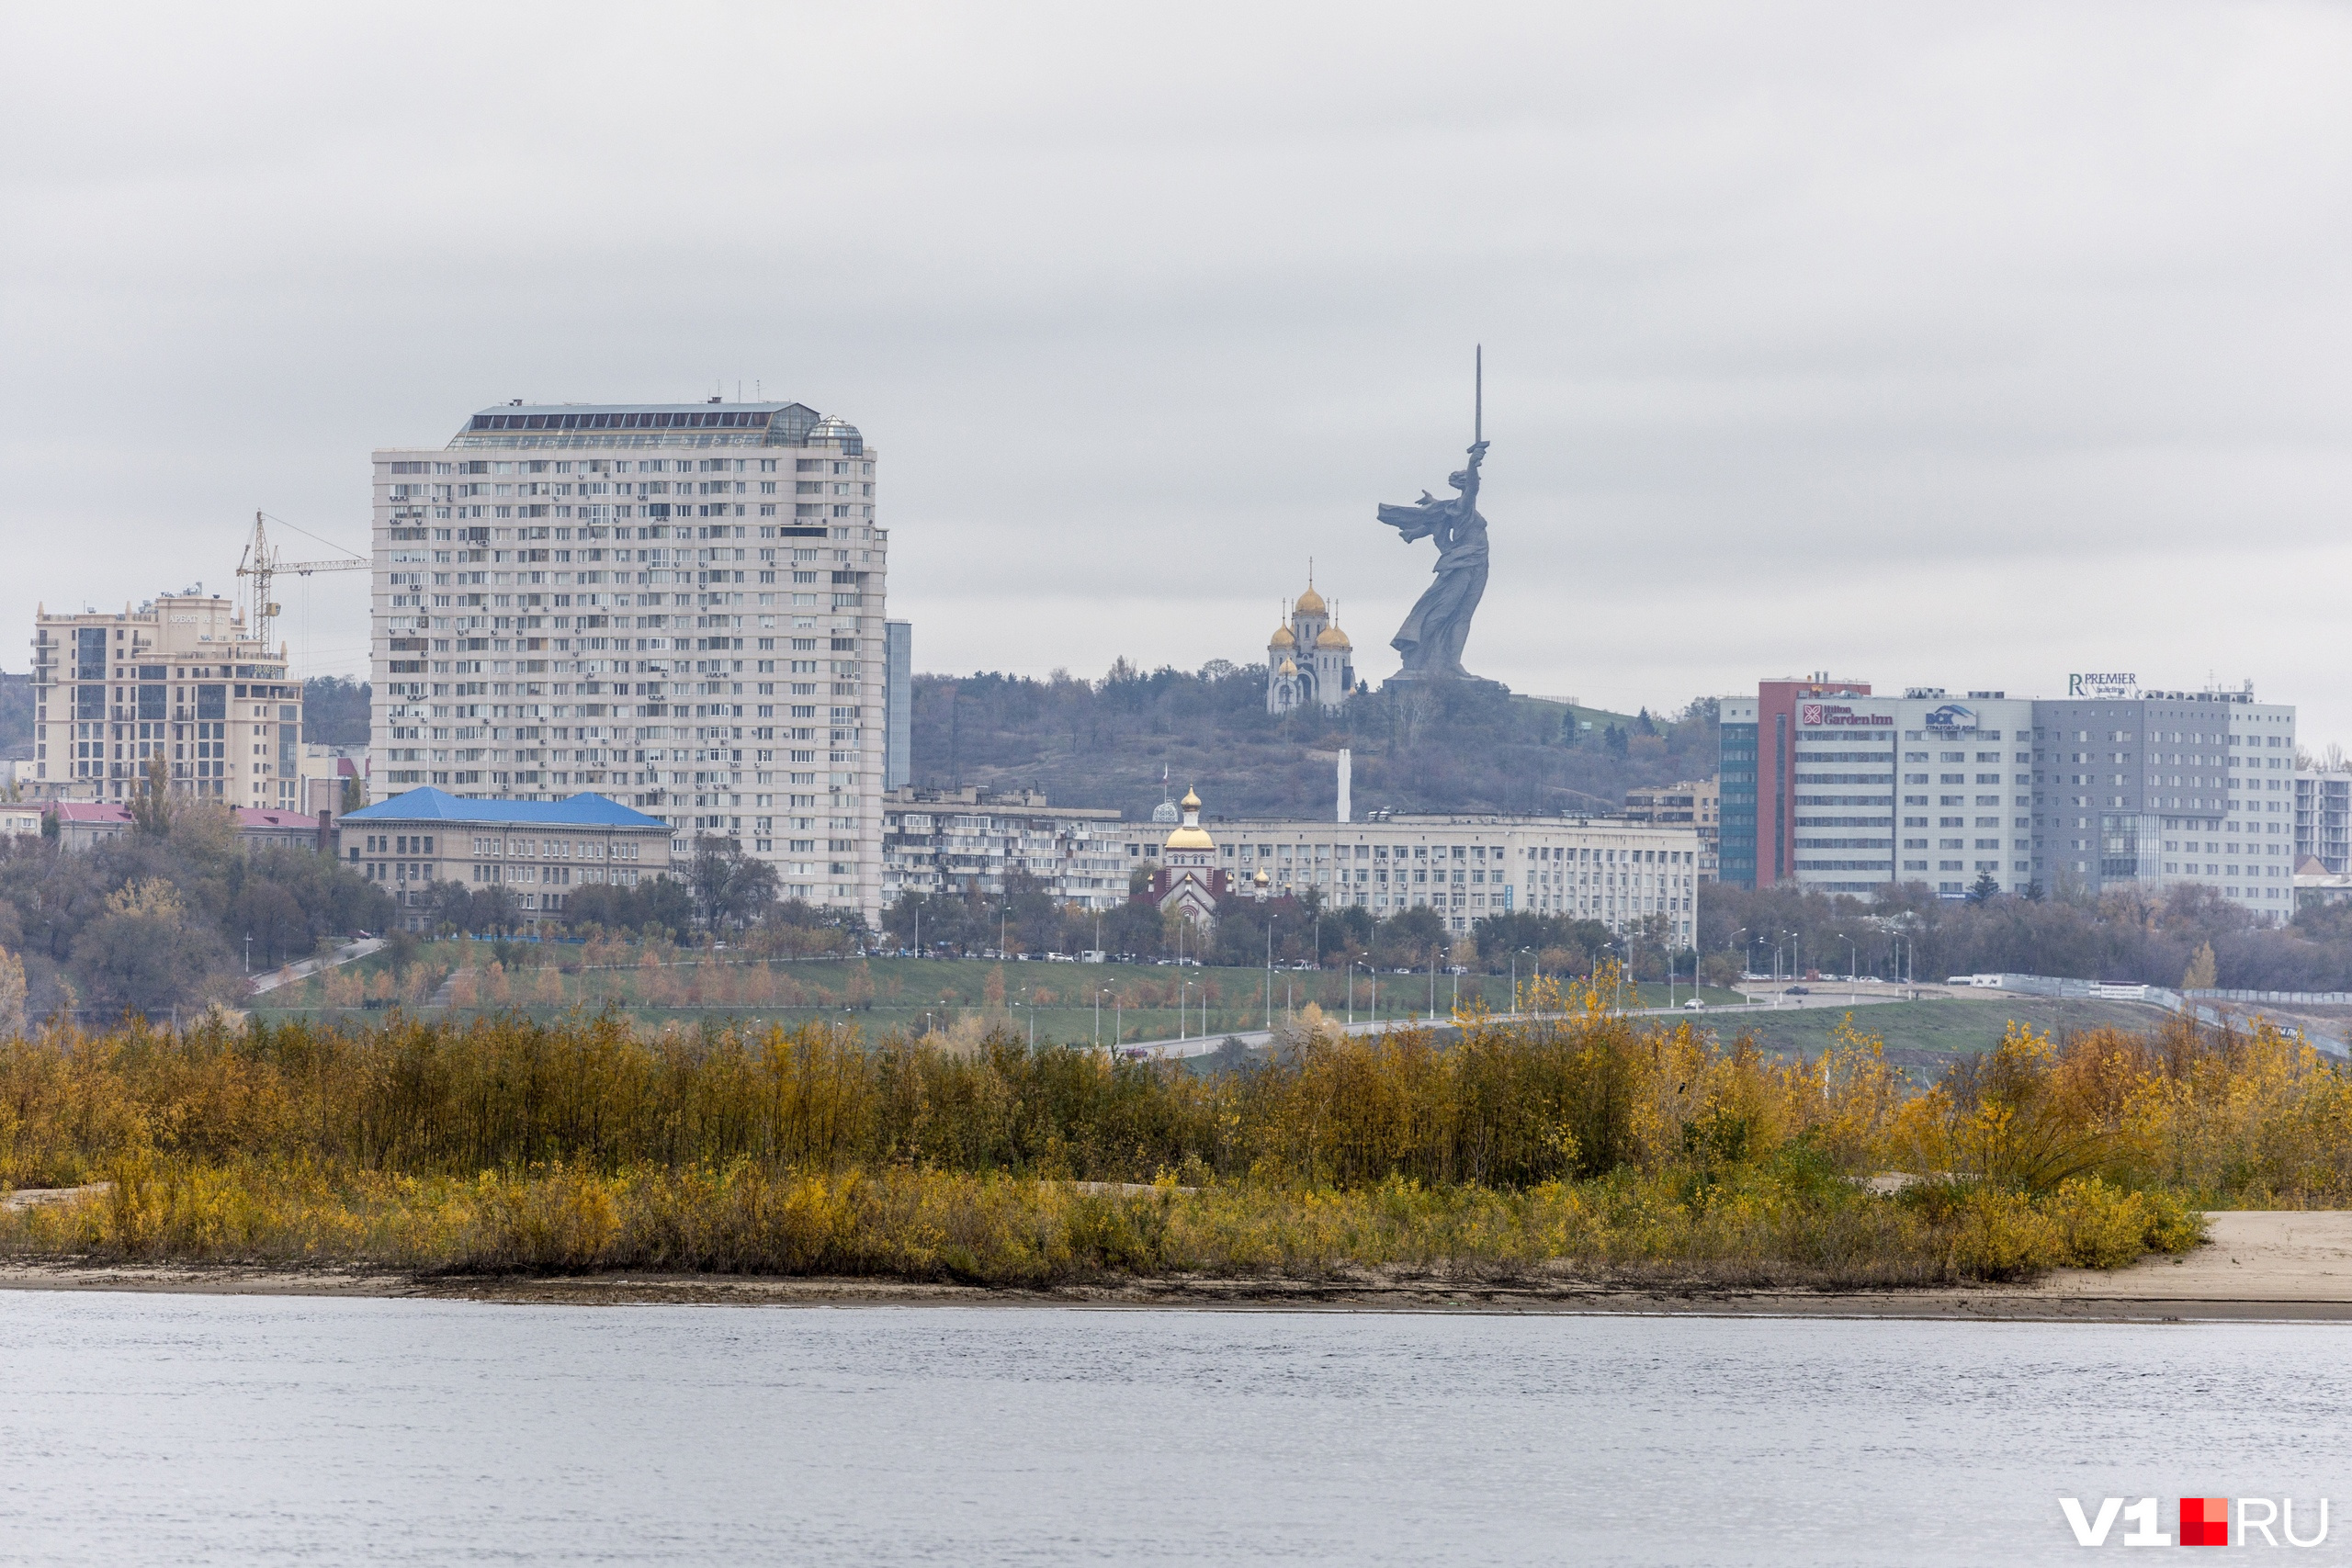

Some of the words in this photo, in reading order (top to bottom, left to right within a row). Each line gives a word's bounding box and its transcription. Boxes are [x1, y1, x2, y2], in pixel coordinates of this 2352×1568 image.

[2085, 673, 2136, 683] PREMIER
[2097, 686, 2125, 694] building
[1824, 714, 1870, 725] Garden
[1871, 714, 1893, 725] Inn
[1926, 713, 1954, 725] ВСК
